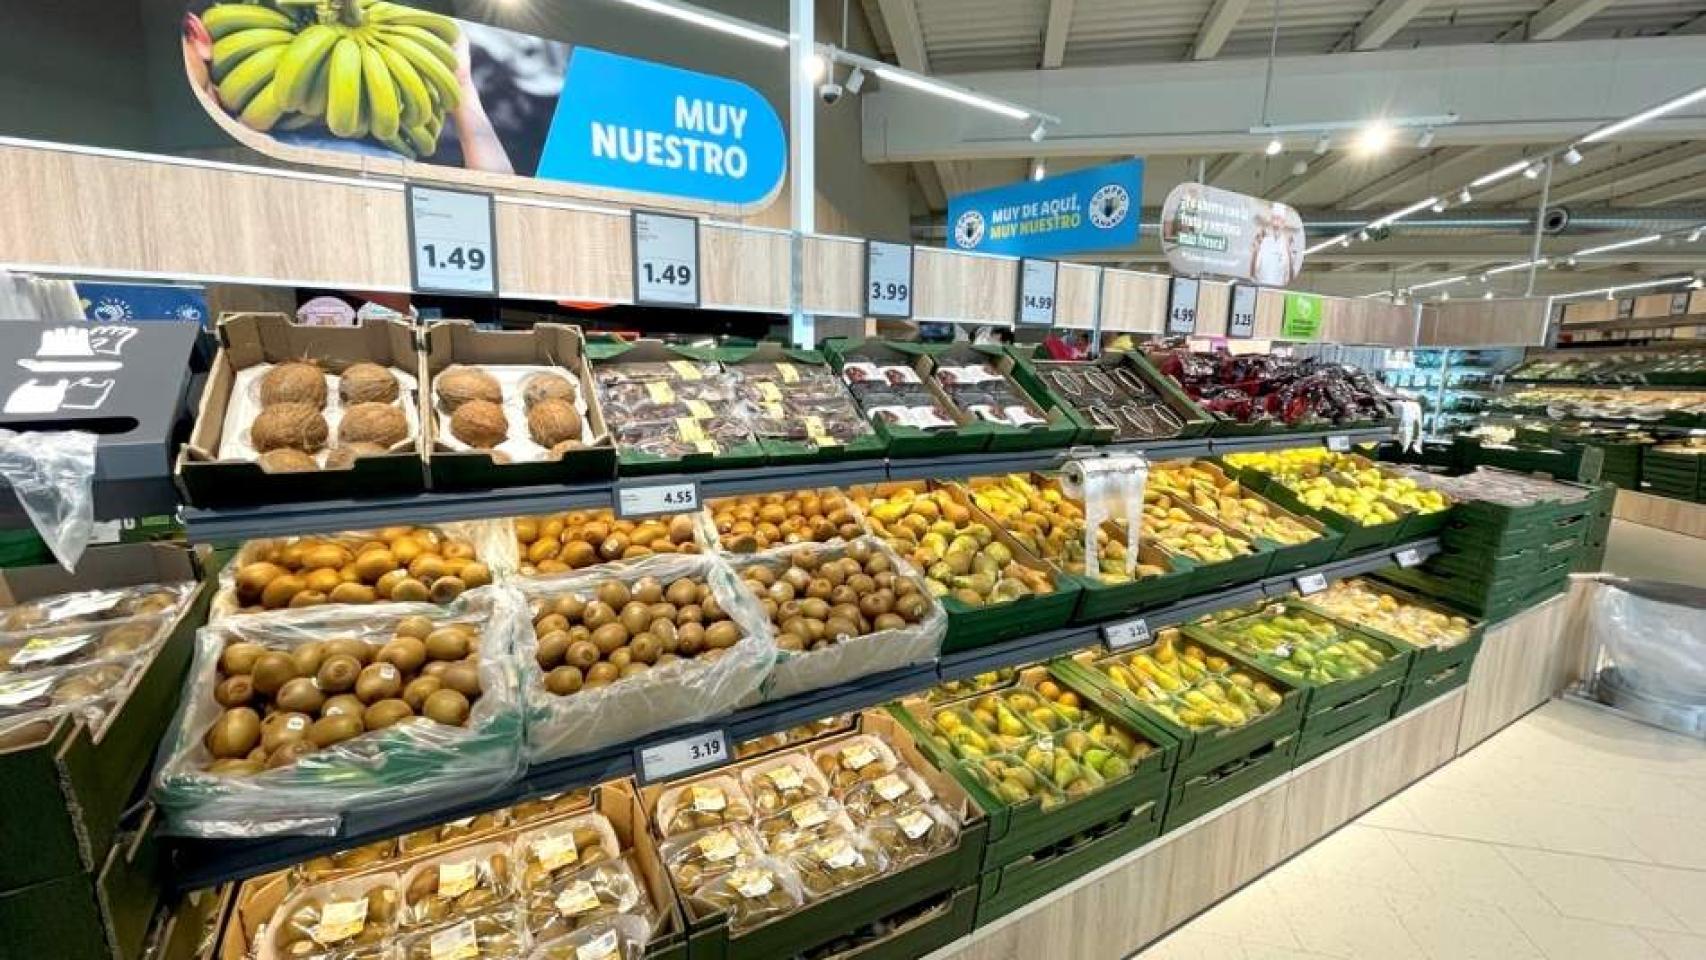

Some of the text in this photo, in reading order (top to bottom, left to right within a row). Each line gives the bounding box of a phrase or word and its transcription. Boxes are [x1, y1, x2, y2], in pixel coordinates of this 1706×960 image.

[675, 95, 748, 139] MUY
[591, 121, 748, 179] NUESTRO
[992, 204, 1021, 223] MUY
[1022, 203, 1039, 216] DE
[990, 224, 1017, 240] MUY
[1019, 213, 1081, 235] NUESTRO
[422, 243, 486, 271] 1.49
[643, 263, 691, 285] 1.49
[871, 282, 908, 301] 3.99
[664, 491, 692, 503] 4.55
[690, 740, 719, 759] 3.19
